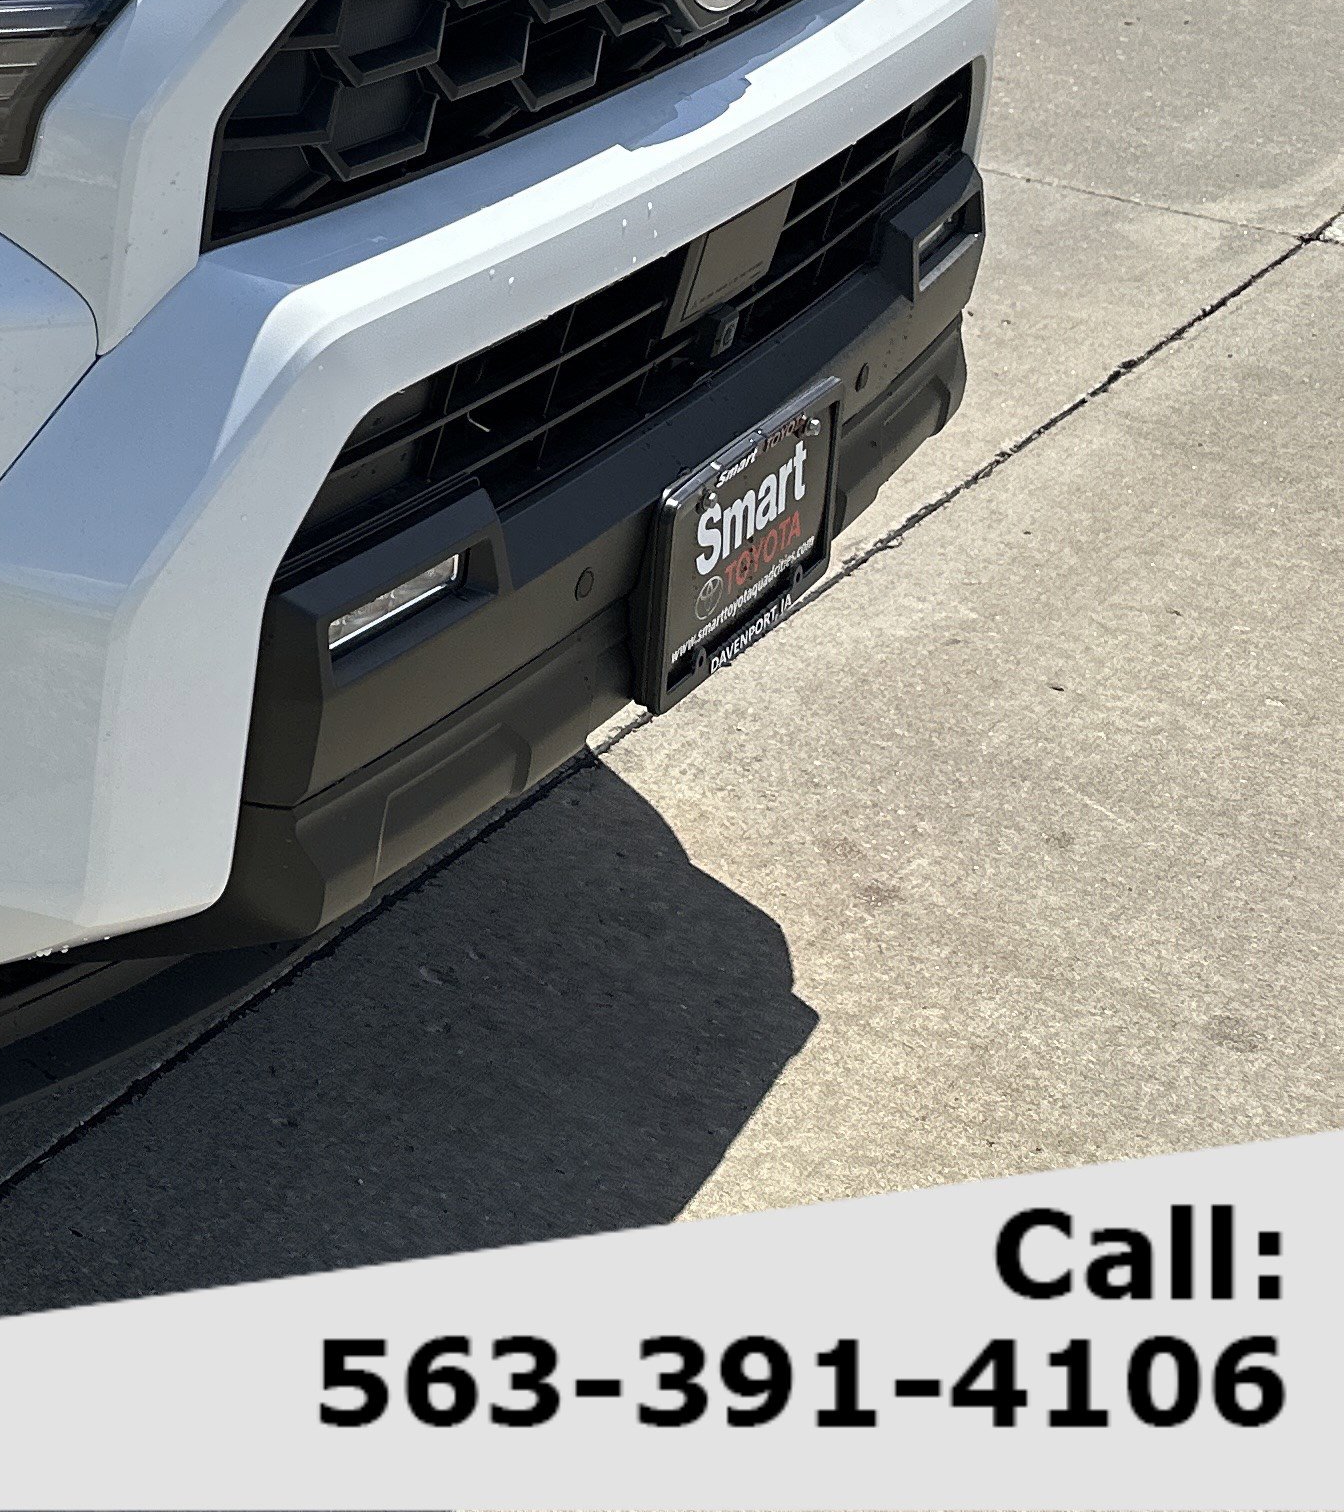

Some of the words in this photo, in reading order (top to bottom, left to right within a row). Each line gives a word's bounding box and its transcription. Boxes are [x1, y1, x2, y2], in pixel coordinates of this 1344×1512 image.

[696, 440, 807, 575] Smart
[716, 448, 759, 488] Smart
[724, 510, 802, 595] TOYOTA
